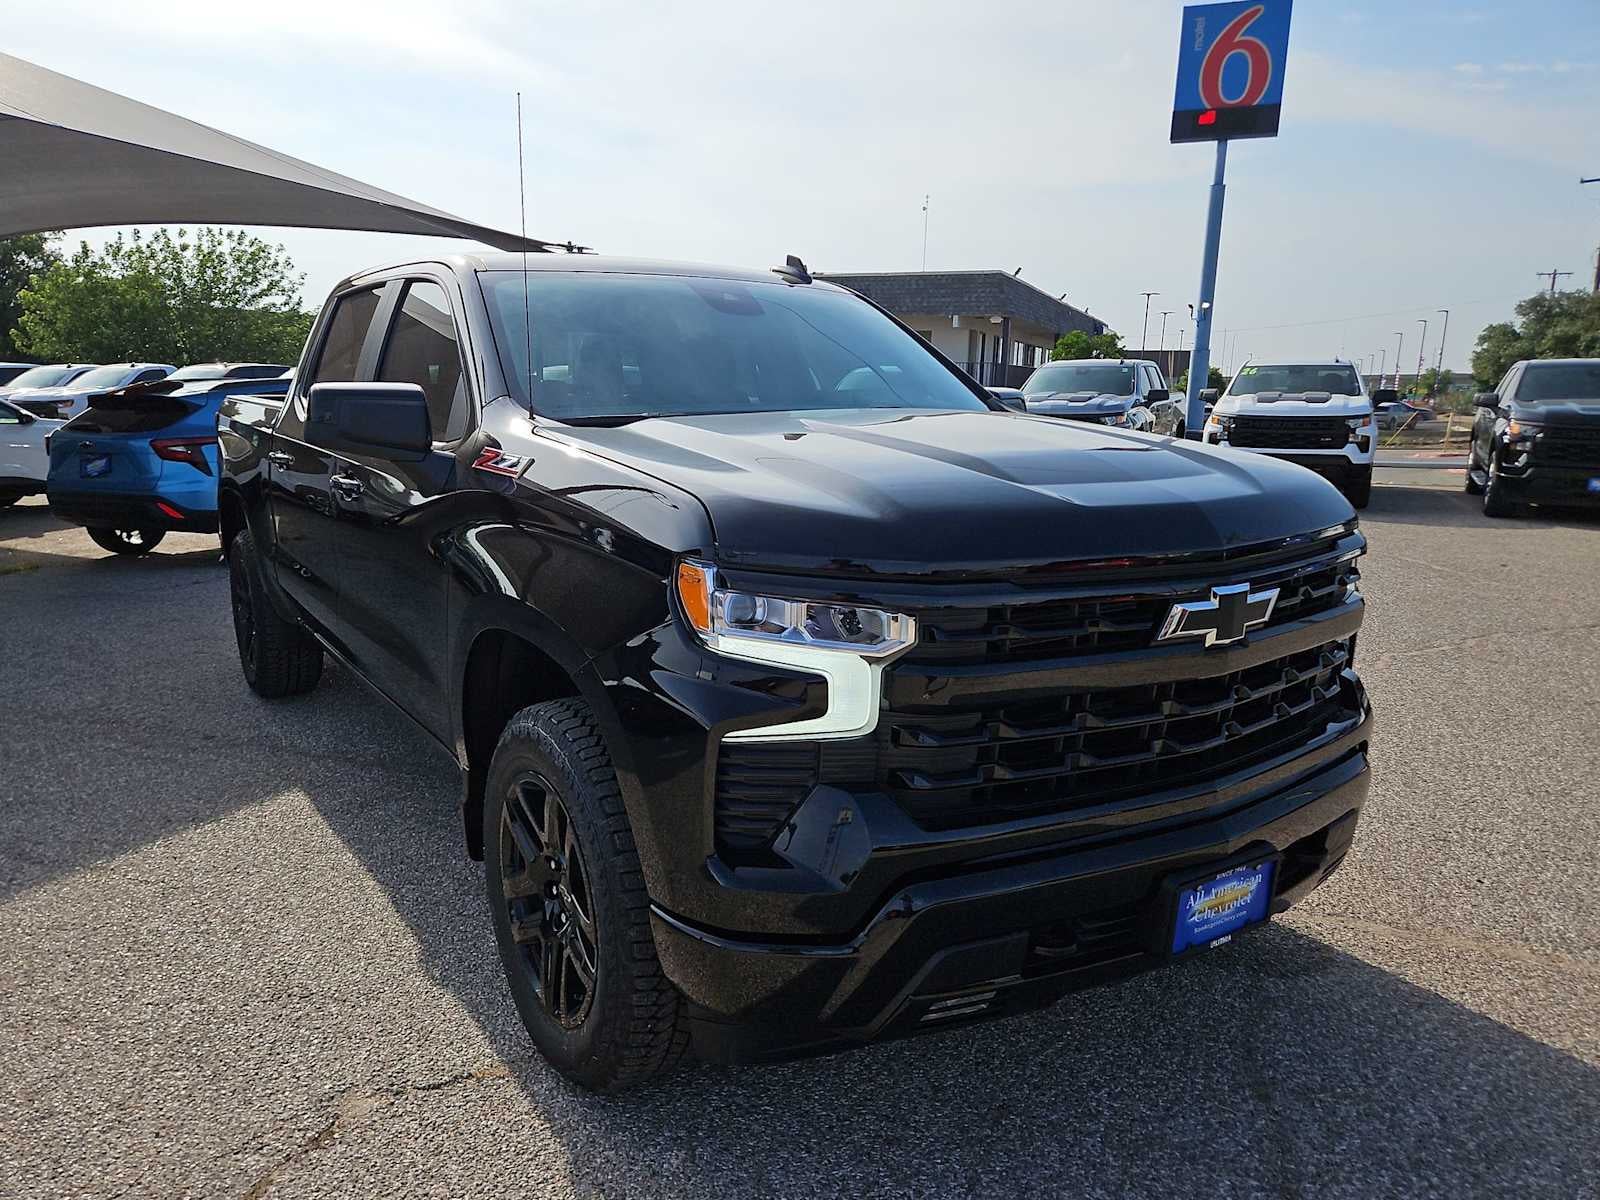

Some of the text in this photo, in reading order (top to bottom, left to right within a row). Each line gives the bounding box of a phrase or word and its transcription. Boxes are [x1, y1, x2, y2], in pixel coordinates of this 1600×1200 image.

[1199, 5, 1272, 109] 6
[1186, 873, 1262, 909] All American
[1195, 893, 1251, 922] Chevrolet
